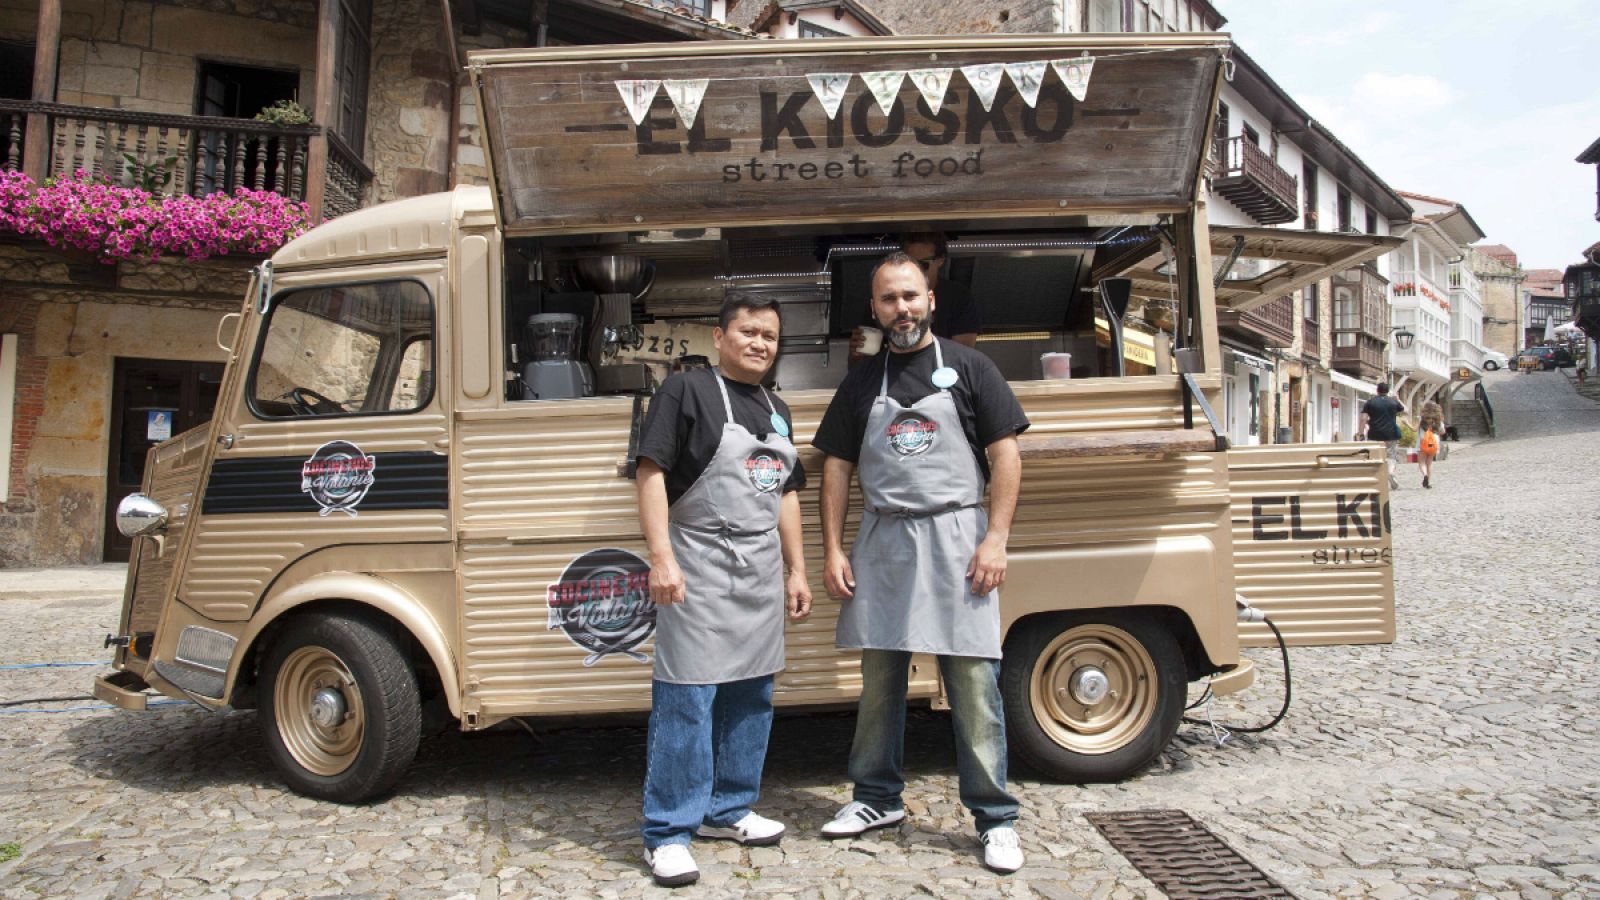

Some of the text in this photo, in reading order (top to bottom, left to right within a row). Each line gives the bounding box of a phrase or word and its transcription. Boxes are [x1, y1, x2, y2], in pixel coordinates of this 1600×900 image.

[632, 64, 1083, 106] EL KIOSKO
[636, 84, 1075, 155] EL KIOSKO
[722, 147, 985, 184] street food
[1251, 495, 1329, 541] EL
